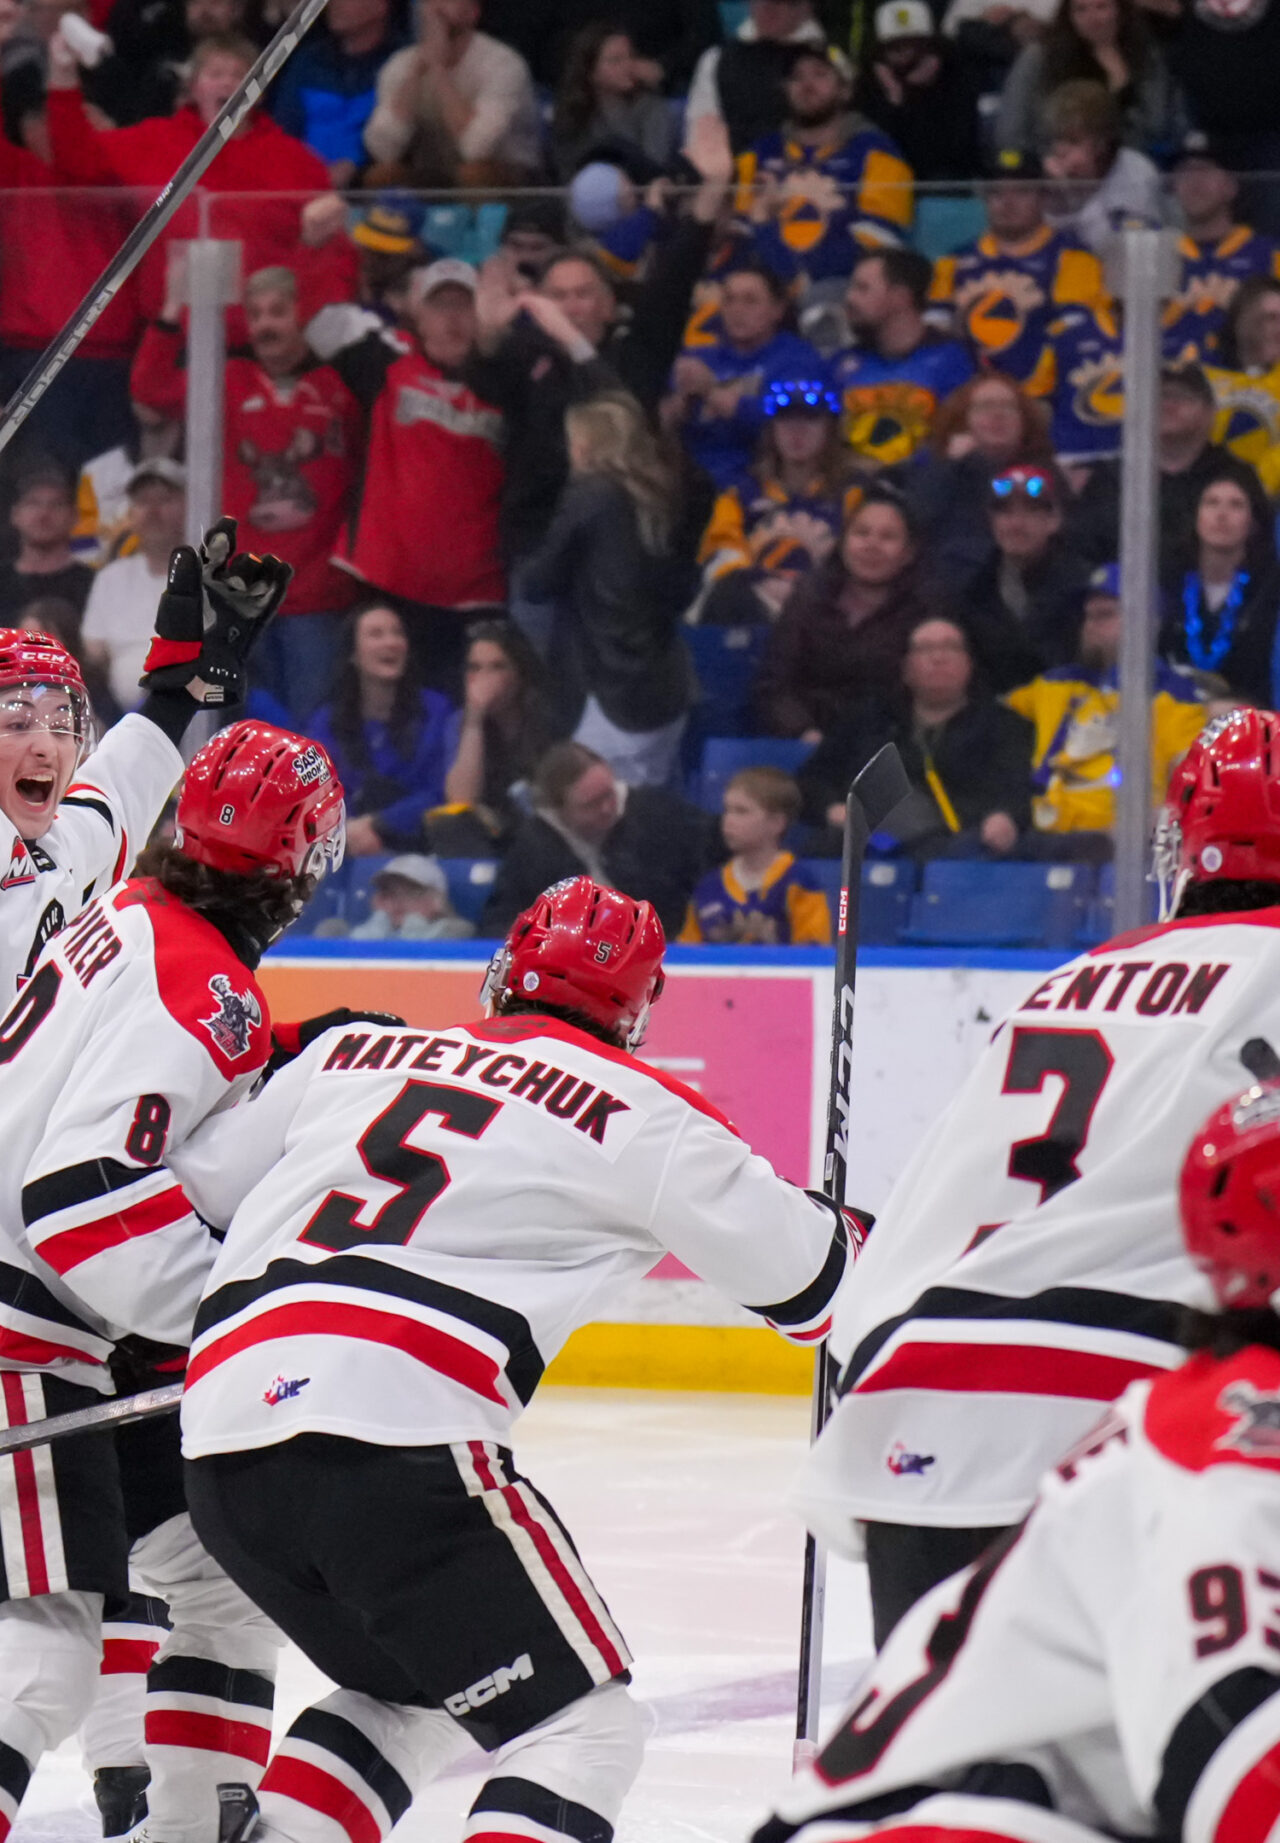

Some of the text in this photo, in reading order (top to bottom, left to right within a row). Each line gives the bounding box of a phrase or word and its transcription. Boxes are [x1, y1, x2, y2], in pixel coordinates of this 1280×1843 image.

[21, 651, 67, 663] CCM
[293, 746, 320, 773] SASK
[220, 803, 235, 825] 8
[594, 941, 612, 964] 5
[1019, 961, 1232, 1017] ENTON
[321, 1033, 632, 1145] MATEYCHUK
[124, 1092, 172, 1168] 8
[298, 1077, 506, 1253] 5
[443, 1652, 535, 1717] CCM
